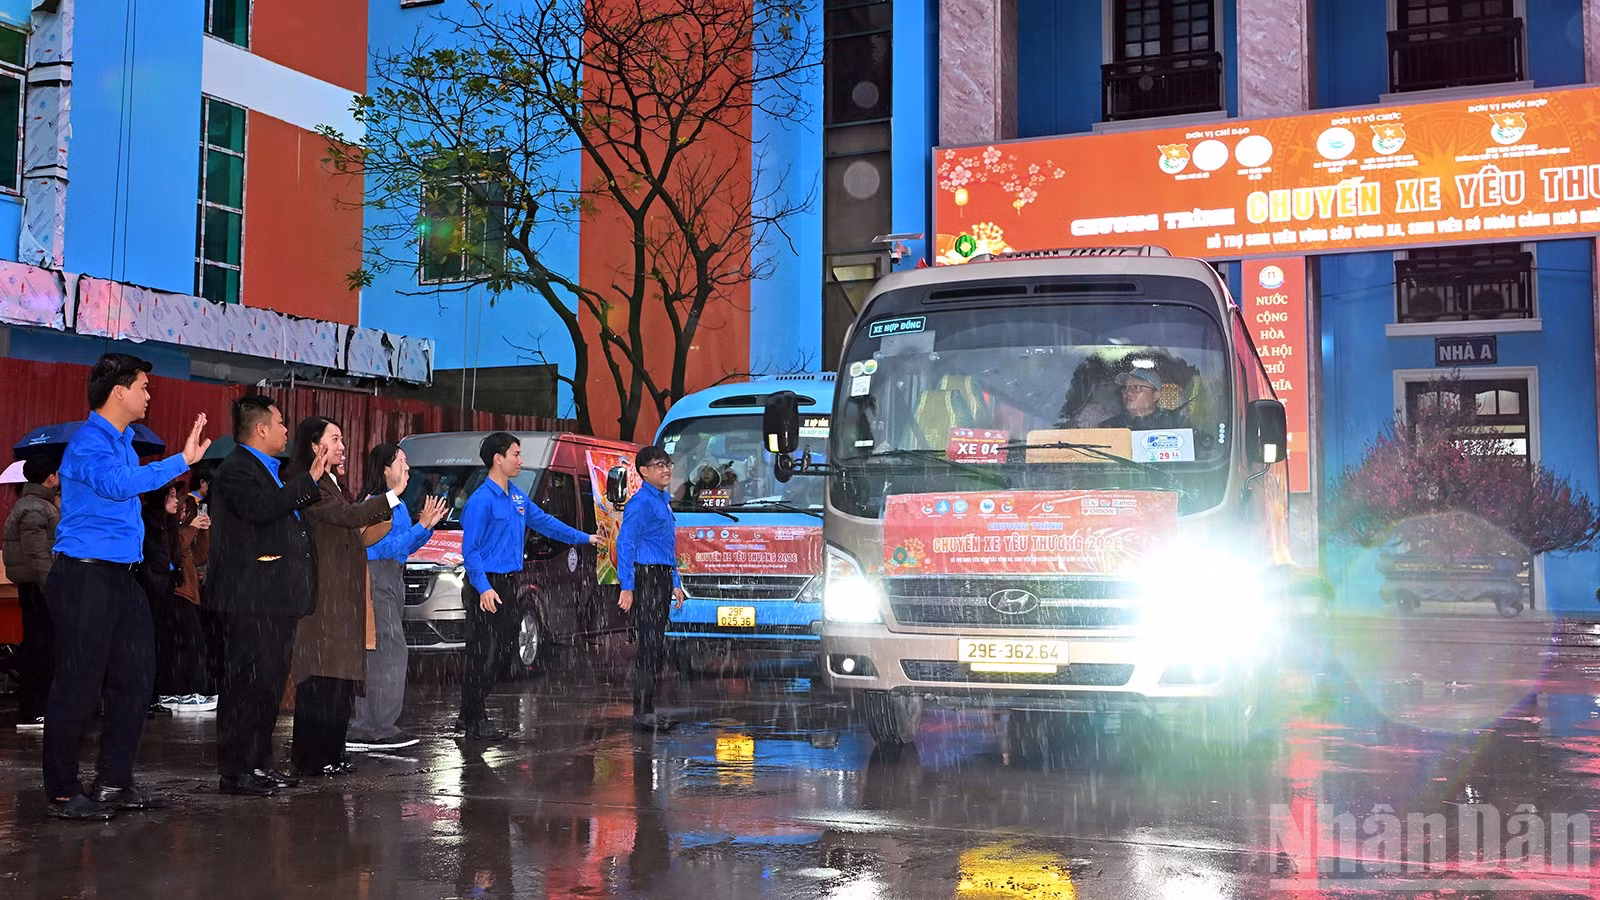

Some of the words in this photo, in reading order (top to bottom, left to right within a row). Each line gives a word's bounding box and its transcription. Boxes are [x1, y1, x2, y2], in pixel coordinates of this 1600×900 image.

[1246, 176, 1380, 224] CHUYẾN
[1395, 176, 1441, 213] XE
[1454, 163, 1526, 209] YÊU
[1256, 293, 1288, 306] NƯỚC
[1256, 310, 1288, 325] CỘNG
[872, 325, 883, 334] XE
[884, 322, 899, 333] HỢP
[1260, 327, 1285, 340] HÒA
[1271, 344, 1292, 358] HỘI
[1440, 342, 1475, 361] NHÀ
[1480, 344, 1492, 359] A
[1271, 379, 1292, 391] HĨA
[957, 443, 978, 455] XE
[981, 443, 999, 455] 04
[702, 499, 714, 507] XE
[715, 499, 725, 507] 02
[933, 533, 980, 553] CHUYẾN
[984, 536, 1000, 552] XE
[1003, 531, 1028, 552] YÊU
[1031, 533, 1083, 552] THƯƠNG
[778, 552, 798, 563] 2026
[728, 607, 744, 616] 29F
[721, 617, 751, 626] 025.36
[967, 643, 1060, 660] 29E-362.64
